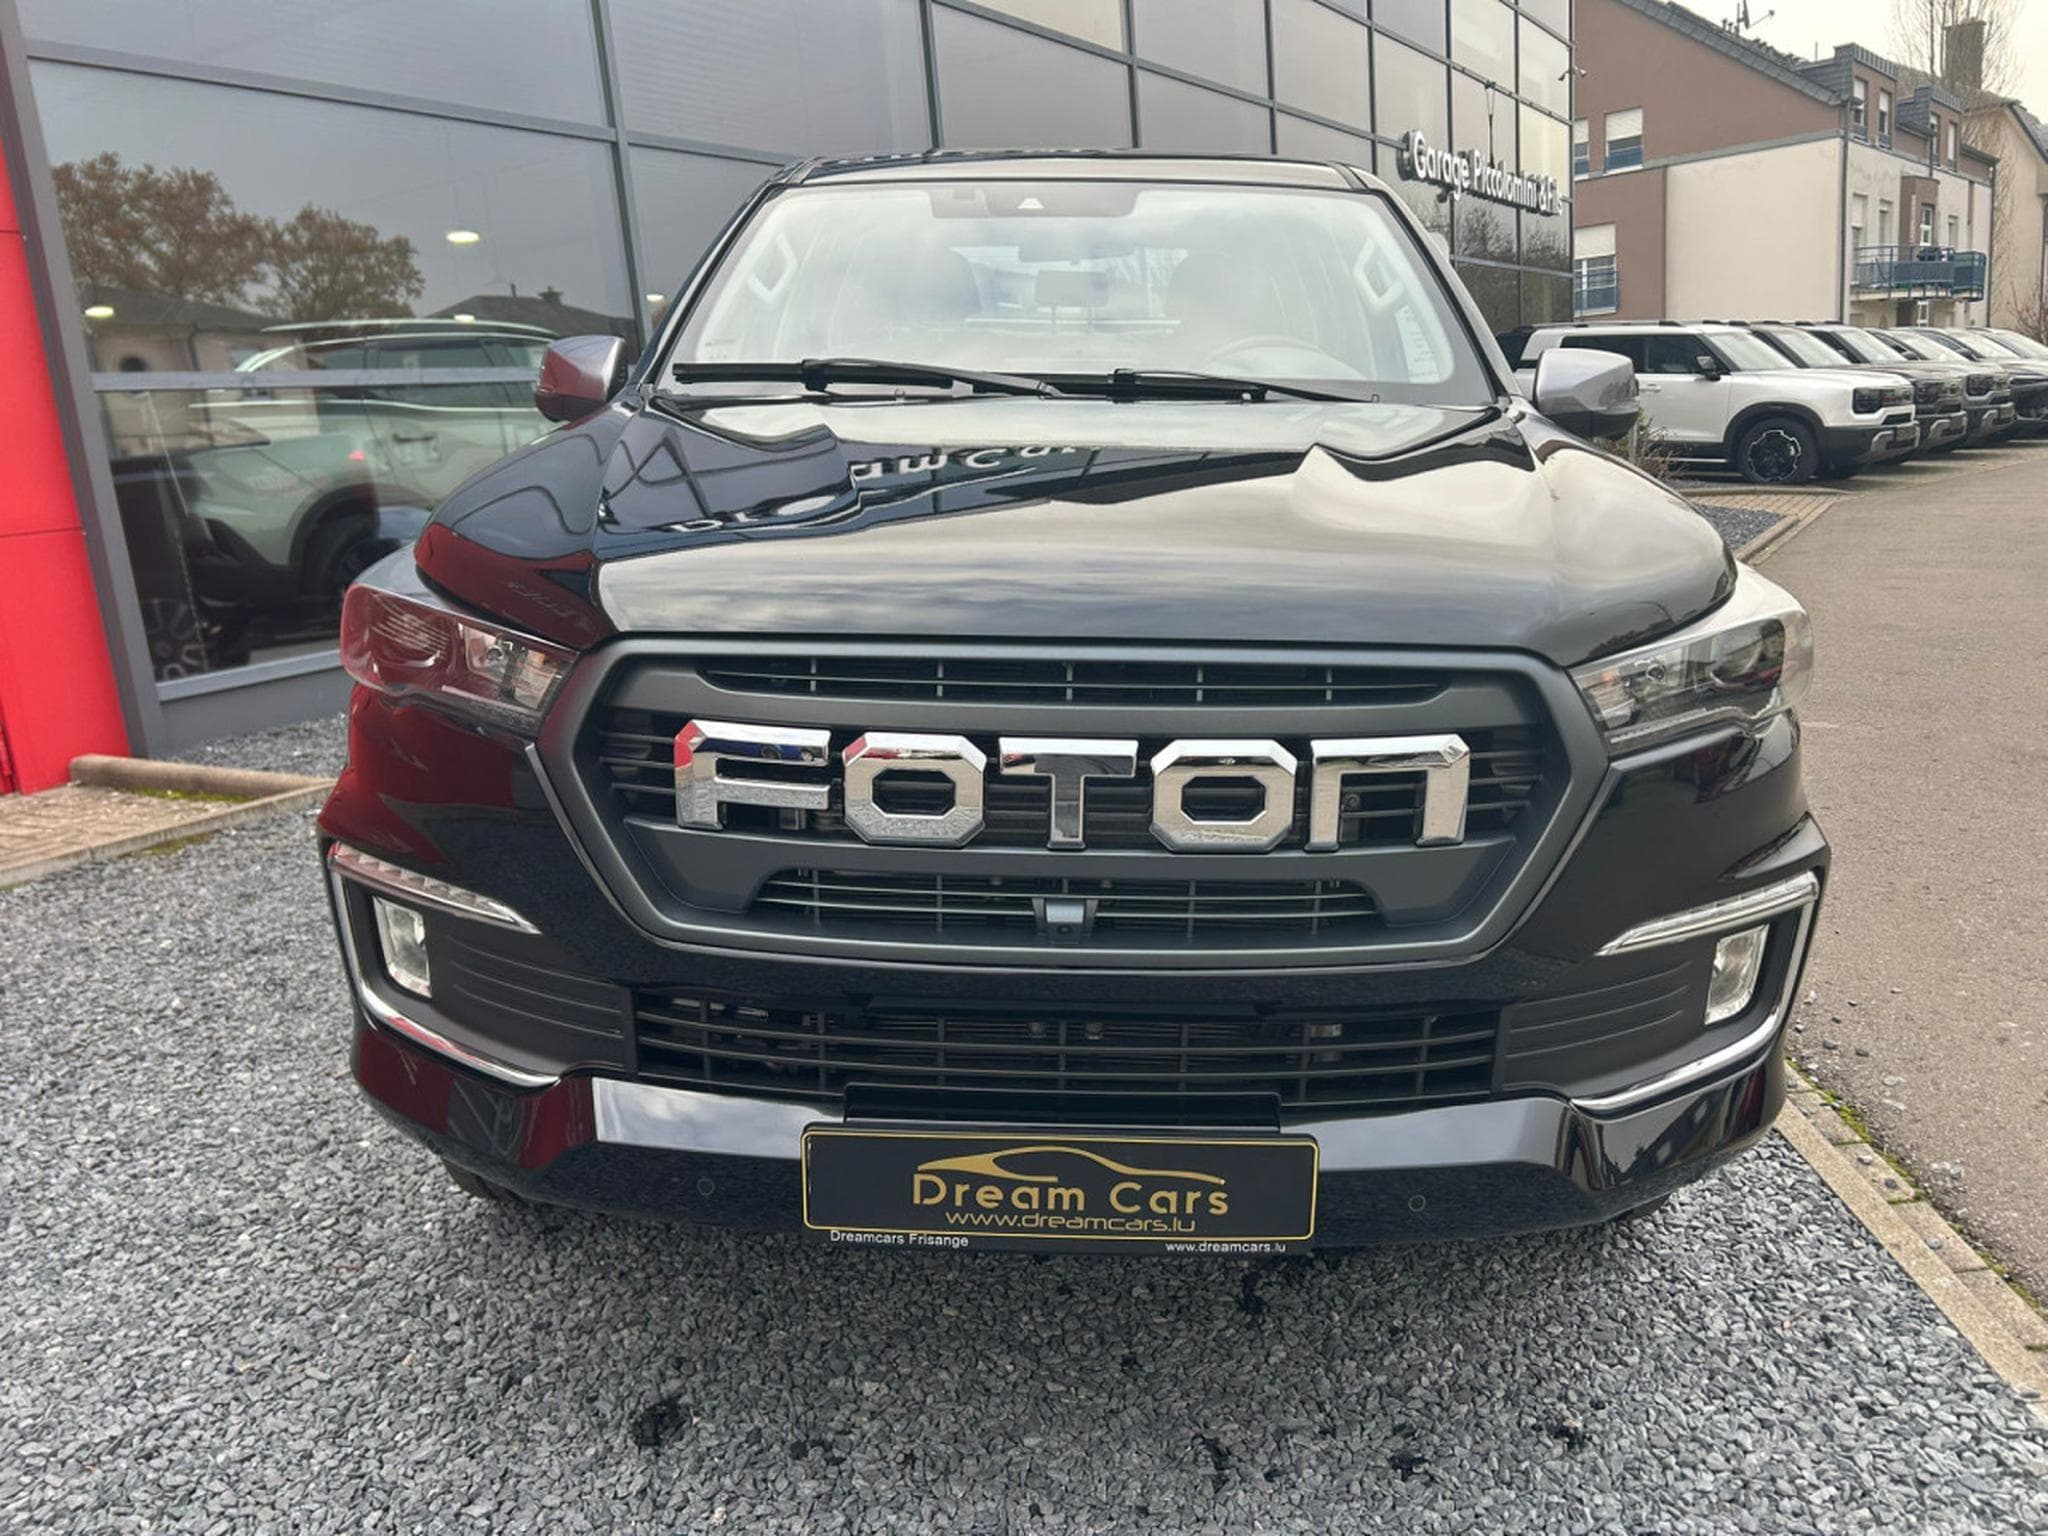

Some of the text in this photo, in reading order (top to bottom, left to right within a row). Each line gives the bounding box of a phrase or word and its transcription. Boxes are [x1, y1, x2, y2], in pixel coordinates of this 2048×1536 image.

[1413, 130, 1471, 201] Garage
[673, 718, 1470, 854] FOTON
[912, 1173, 1230, 1215] Dream Cars
[945, 1211, 1196, 1233] www.dreamcars.lu
[829, 1229, 970, 1249] Dreamcars Frisange
[1164, 1240, 1287, 1254] www.dreamcars.lu
